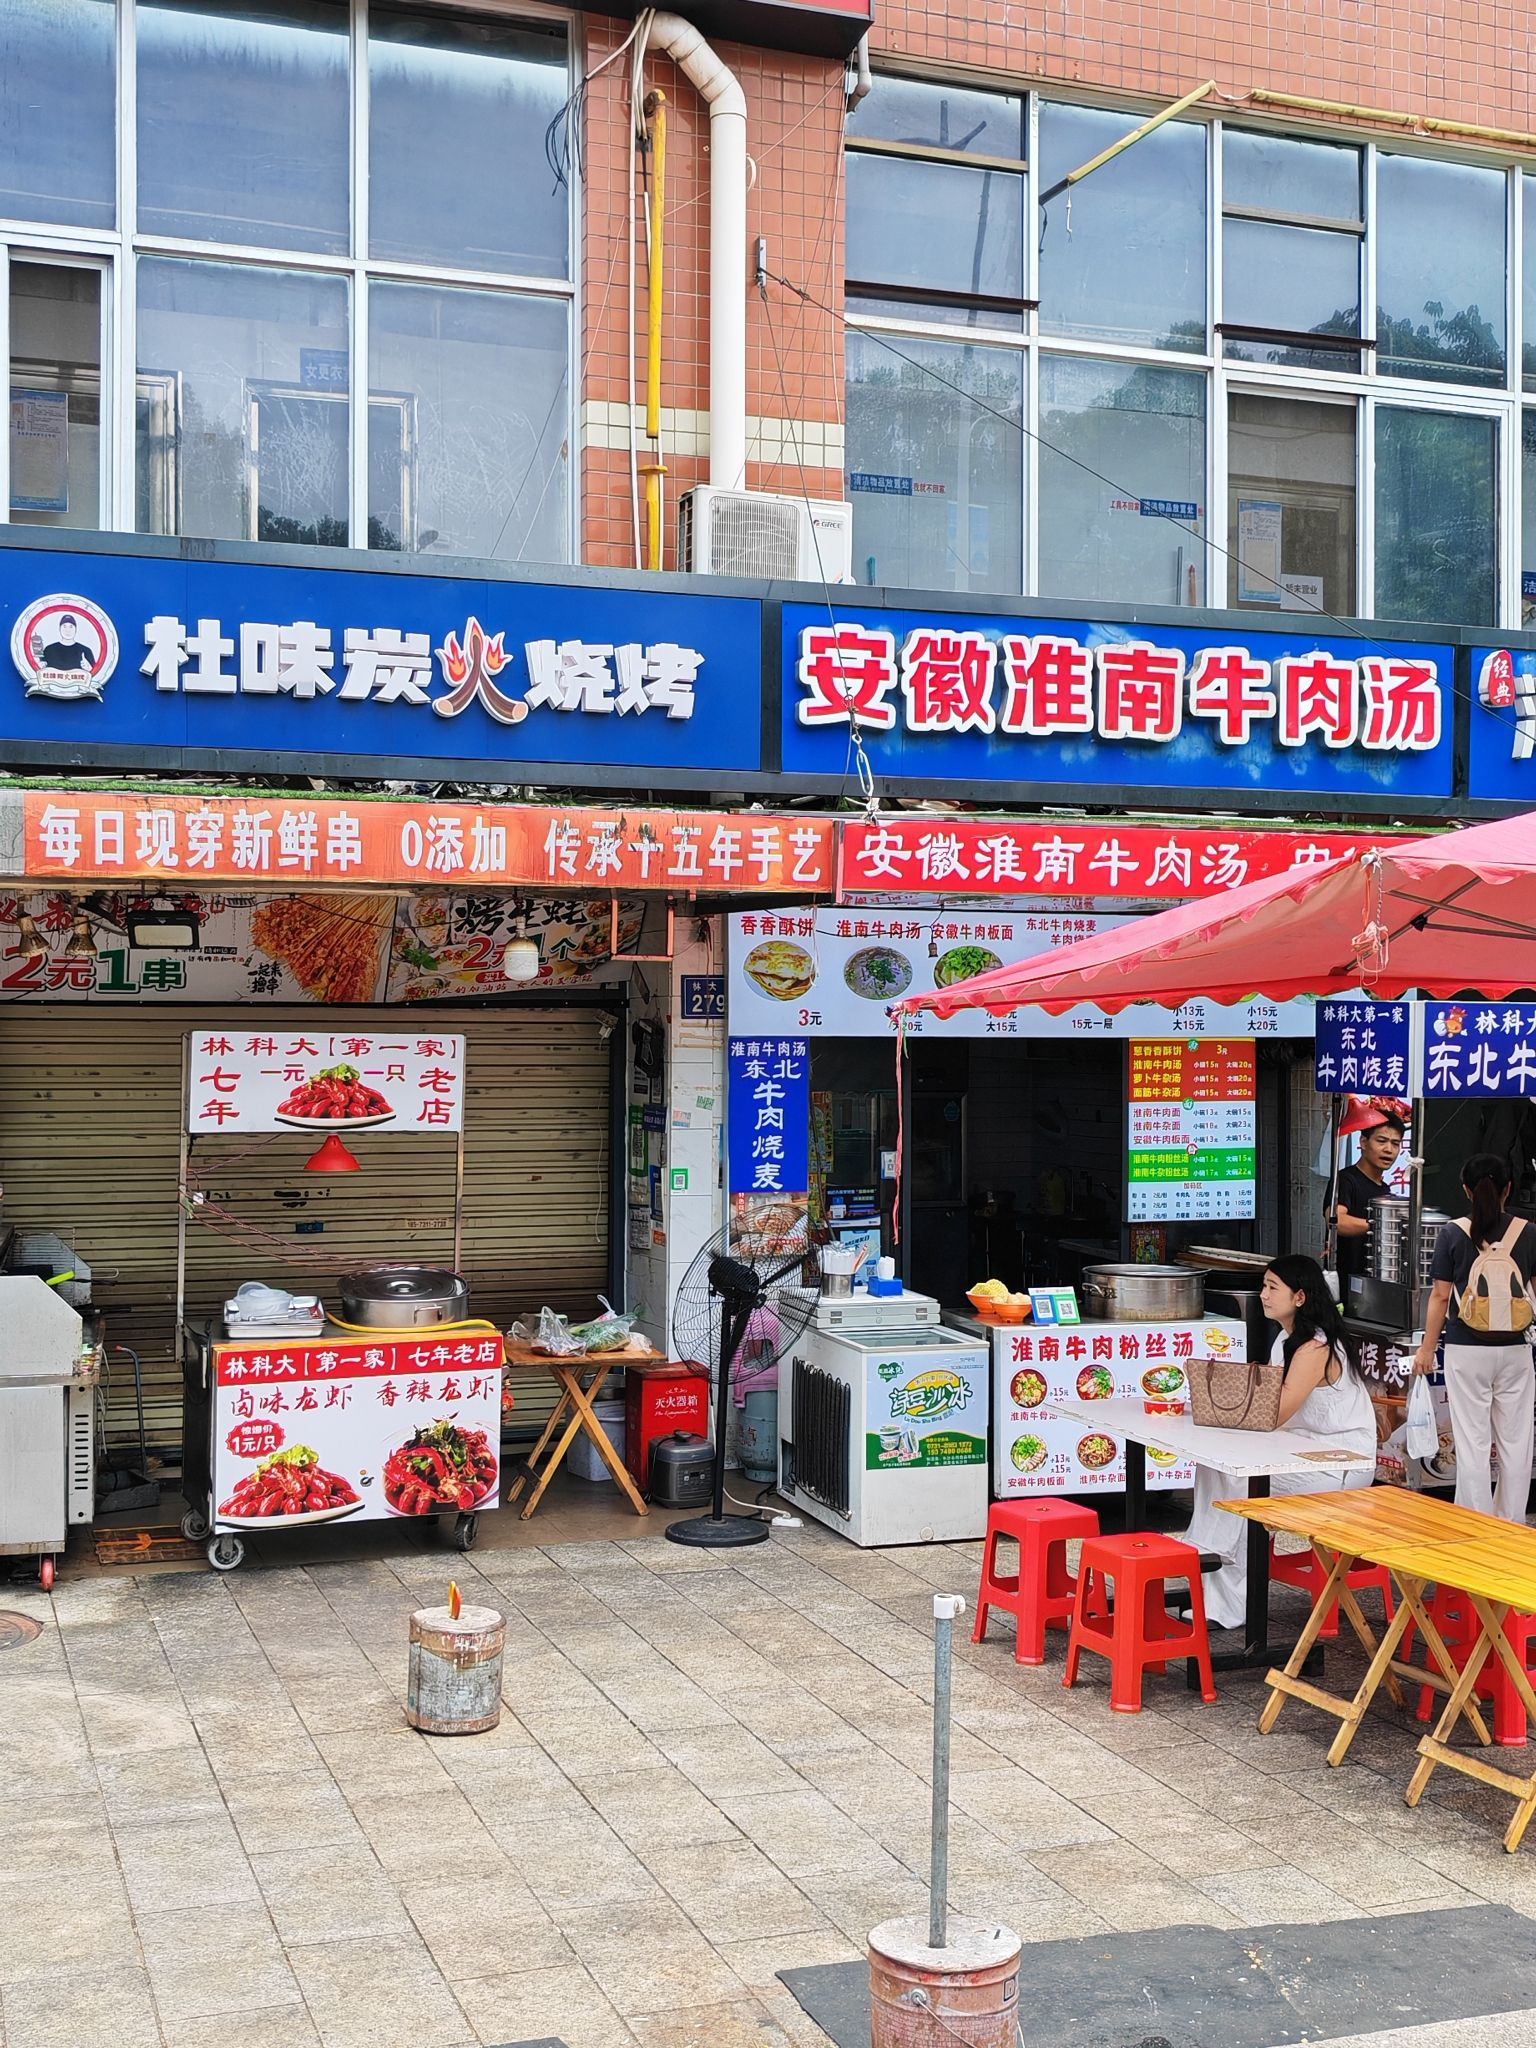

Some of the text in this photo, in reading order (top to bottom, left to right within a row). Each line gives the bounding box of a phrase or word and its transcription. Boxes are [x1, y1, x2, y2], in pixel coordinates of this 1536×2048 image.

[143, 616, 705, 725] 杜味炭火烧烤
[800, 623, 1443, 751] 安徽淮南牛肉汤
[1492, 657, 1511, 704] 经典
[38, 803, 822, 885] 每日现穿新鲜串 0添加 传承十五年手艺
[856, 829, 1249, 889] 安徽淮南牛肉汤
[454, 893, 589, 936] 烤生蚝
[740, 915, 1097, 941] 香香酥饼 淮南牛肉汤 安徽牛肉板面 东北牛肉烧麦
[1050, 933, 1094, 946] 羊肉烧
[798, 1008, 823, 1027] 3元
[1172, 1005, 1205, 1017] 小13元
[1247, 1005, 1278, 1018] 小15元
[1323, 1005, 1405, 1024] 林科大第一家
[986, 1021, 1018, 1033] 大15元
[1172, 1019, 1205, 1032] 大15元
[1247, 1019, 1278, 1032] 大20元
[1474, 1008, 1536, 1037] 林科
[1341, 1026, 1377, 1051] 东北
[730, 1041, 806, 1058] 淮南牛肉汤
[260, 1063, 306, 1082] 一元
[363, 1063, 406, 1083] 一只
[741, 1058, 802, 1080] 东北
[1133, 1060, 1182, 1070] 淮南牛肉汤
[1317, 1051, 1406, 1093] 牛肉烧麦
[1133, 1108, 1181, 1118] 淮南牛肉面
[751, 1079, 787, 1191] 牛肉烧麦
[1133, 1121, 1181, 1131] 淮南牛杂面
[1133, 1135, 1190, 1145] 安徽牛肉板面
[1011, 1331, 1194, 1362] 淮南牛肉粉丝汤
[1230, 1337, 1244, 1348] 3元
[408, 1341, 498, 1367] 七年老店
[1358, 1341, 1405, 1389] 烧麦
[230, 1374, 496, 1418] 卤味龙虾 香辣龙虾
[655, 1394, 698, 1410] 灭火器箱
[889, 1376, 974, 1418] 绿豆沙冰
[232, 1435, 277, 1454] 1元/只
[1050, 1464, 1072, 1474] 大15元
[1079, 1472, 1127, 1485] 淮南牛杂面
[1007, 1475, 1066, 1488] 安徽牛肉板面
